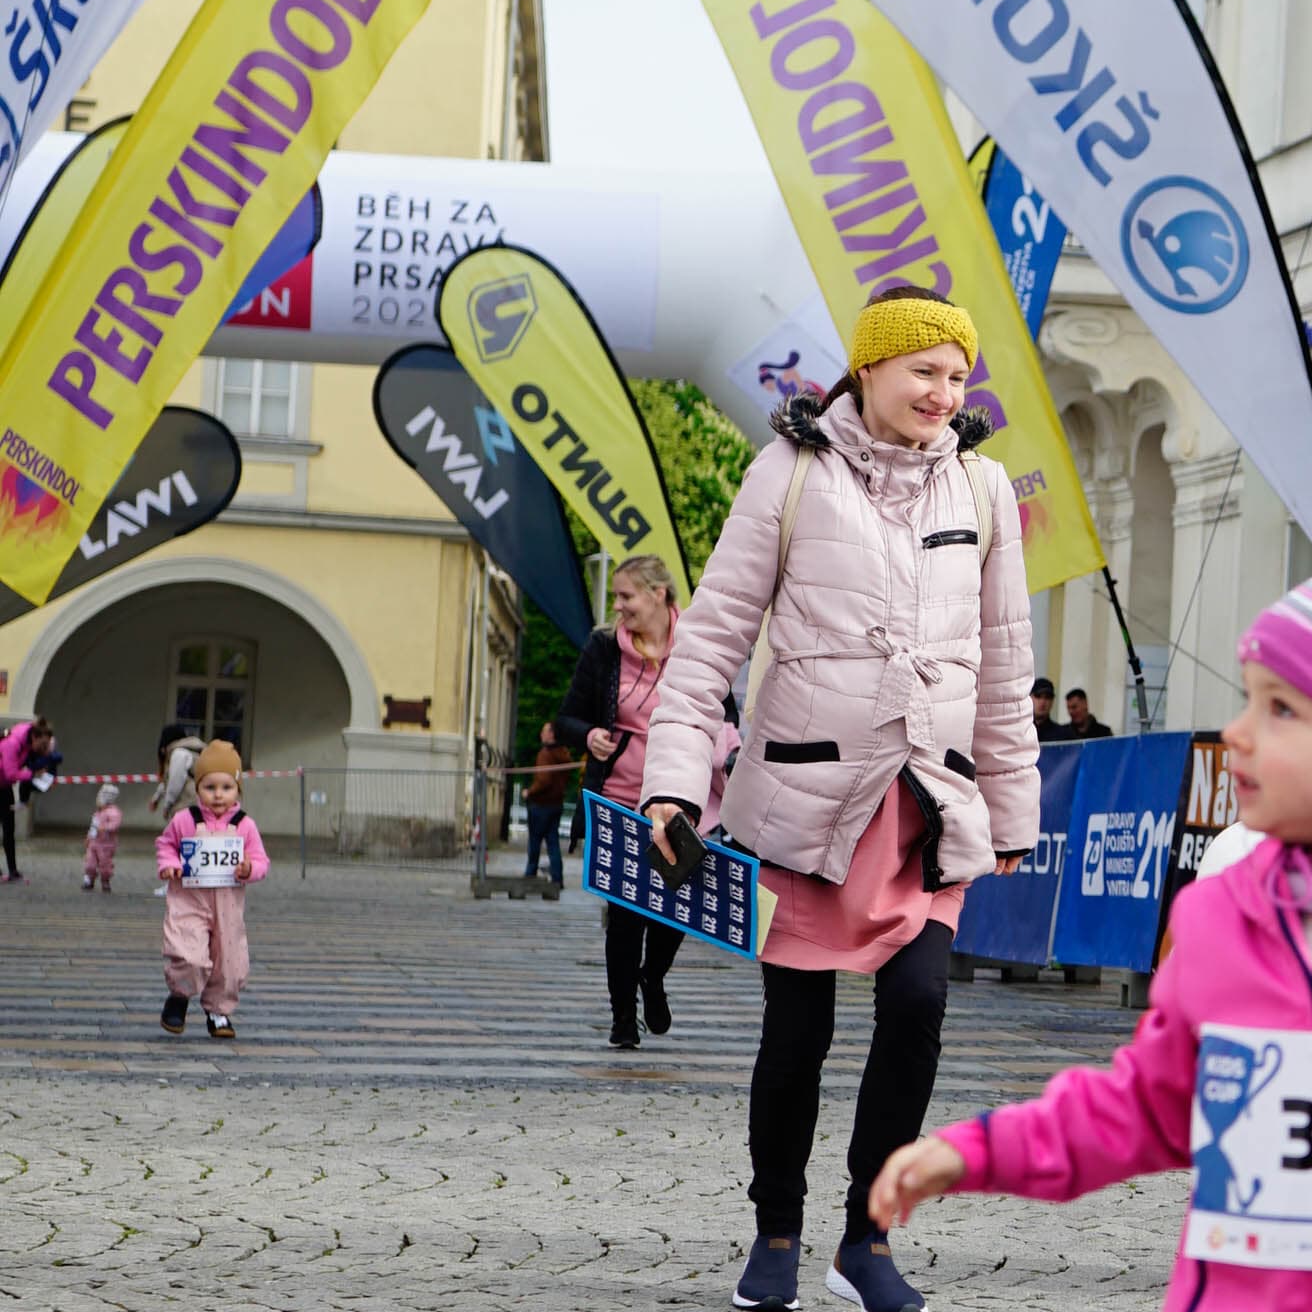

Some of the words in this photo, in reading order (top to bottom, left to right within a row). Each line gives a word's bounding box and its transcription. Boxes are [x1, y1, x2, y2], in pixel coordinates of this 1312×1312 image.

[358, 192, 430, 222] BĚH
[450, 199, 496, 224] ZA
[354, 225, 505, 258] ZDRAV
[200, 851, 240, 866] 3128
